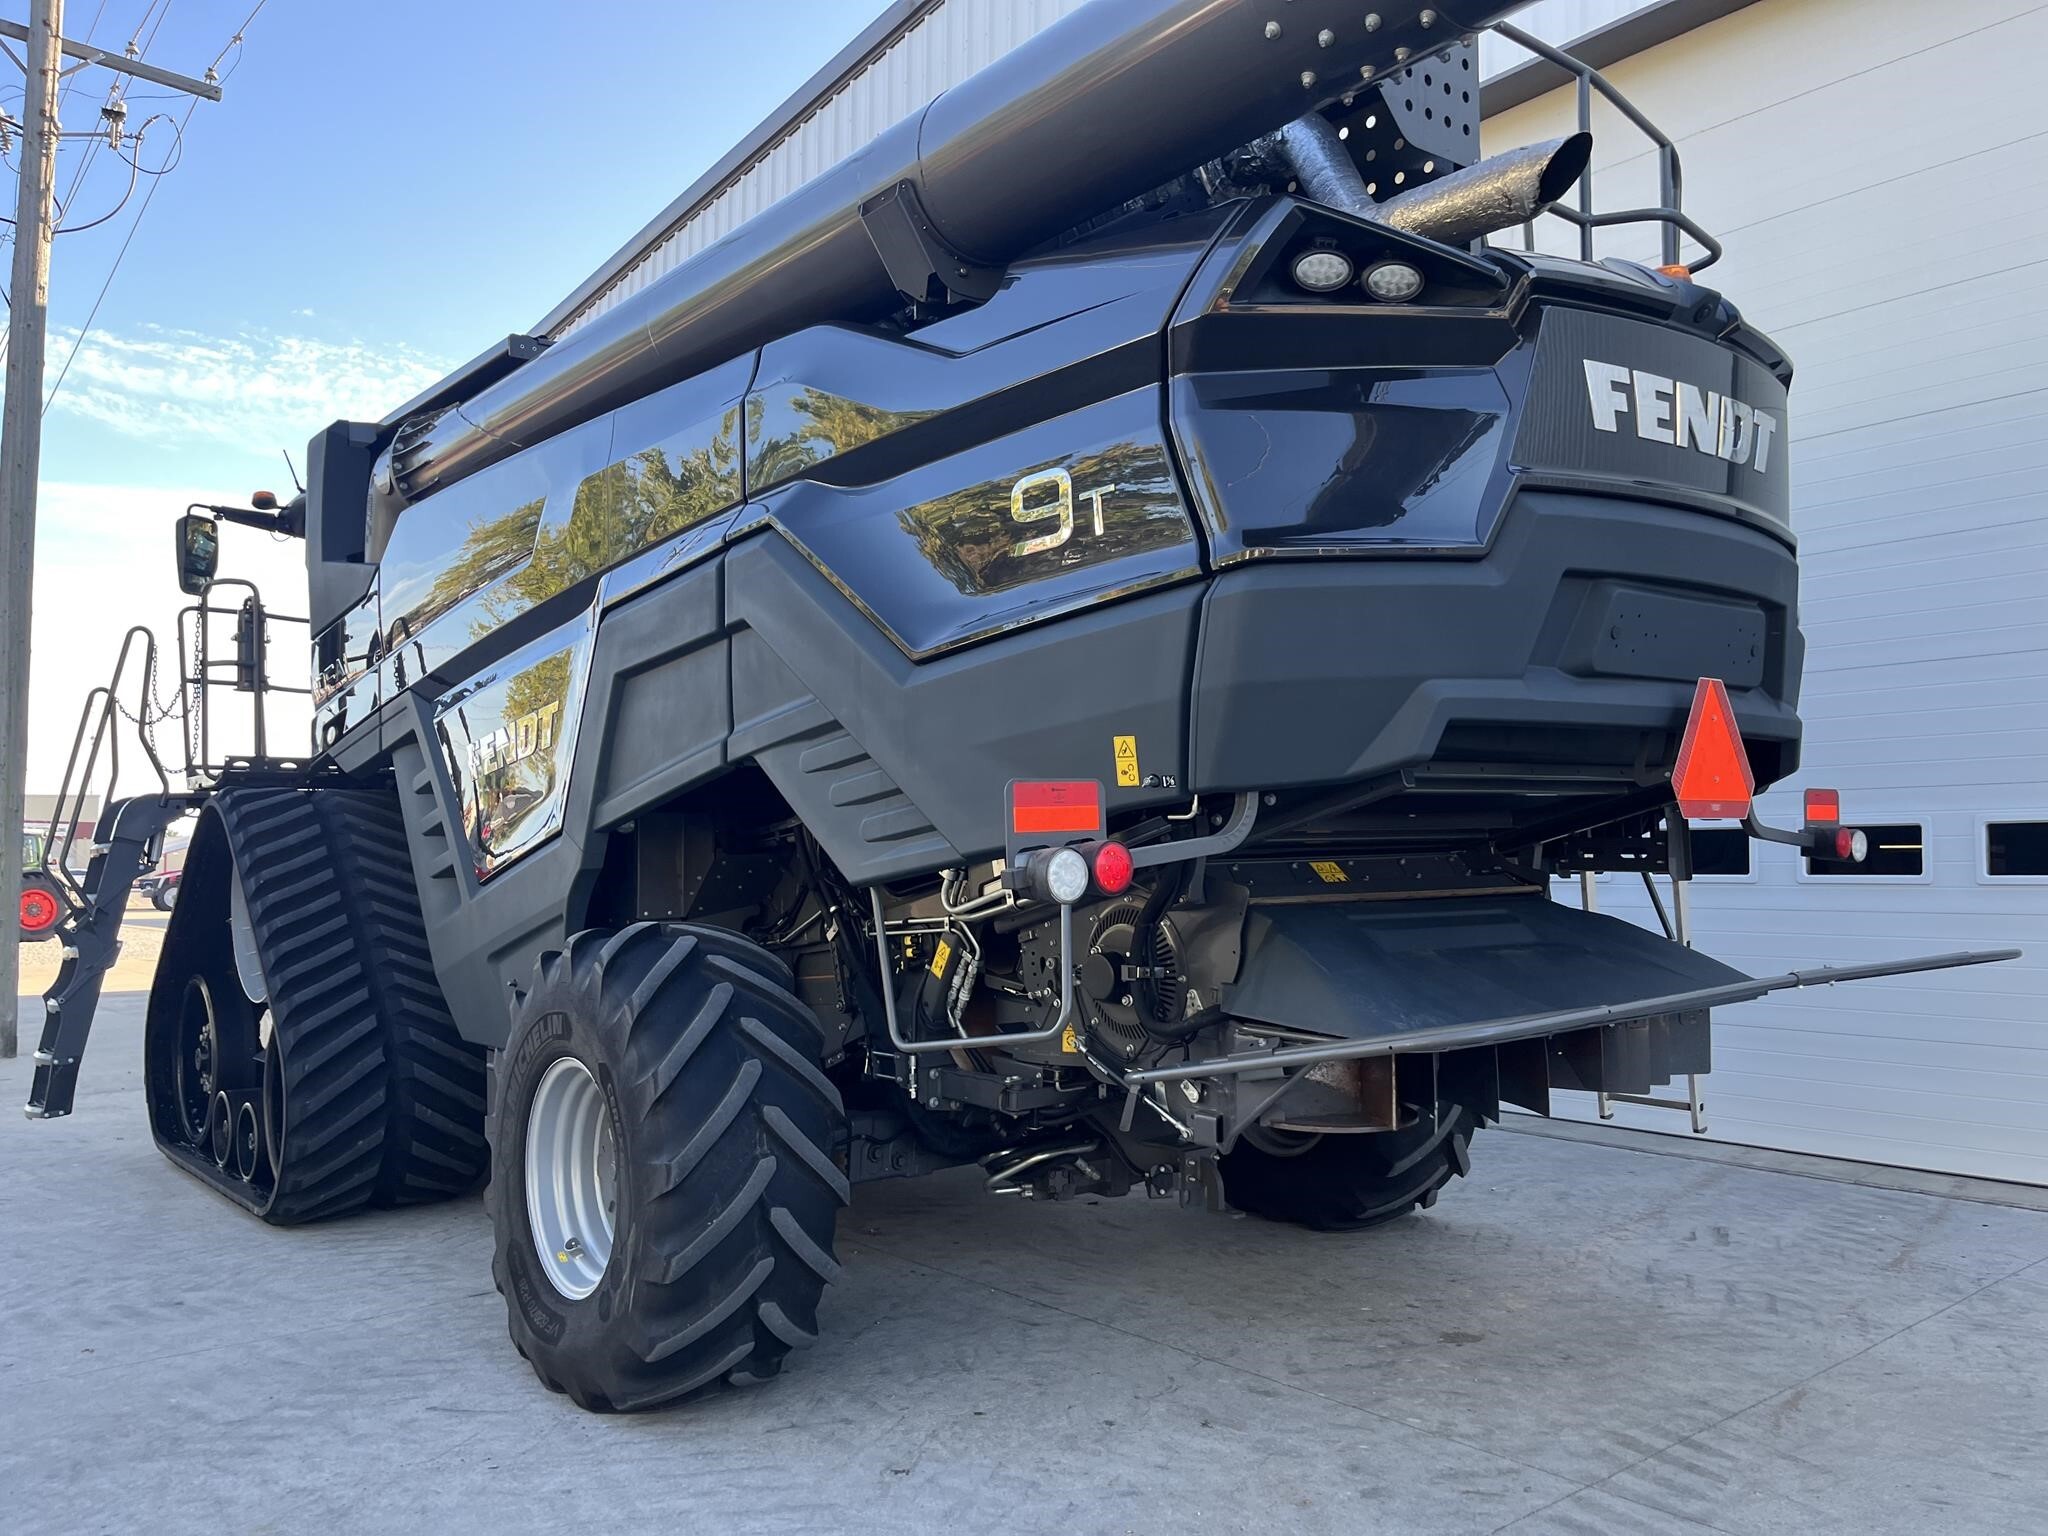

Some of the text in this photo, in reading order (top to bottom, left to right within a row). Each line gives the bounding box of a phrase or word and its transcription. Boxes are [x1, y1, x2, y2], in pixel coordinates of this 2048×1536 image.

[1583, 358, 1776, 474] FENDT
[466, 700, 559, 782] FENDT
[505, 1013, 563, 1113] MICHELIN
